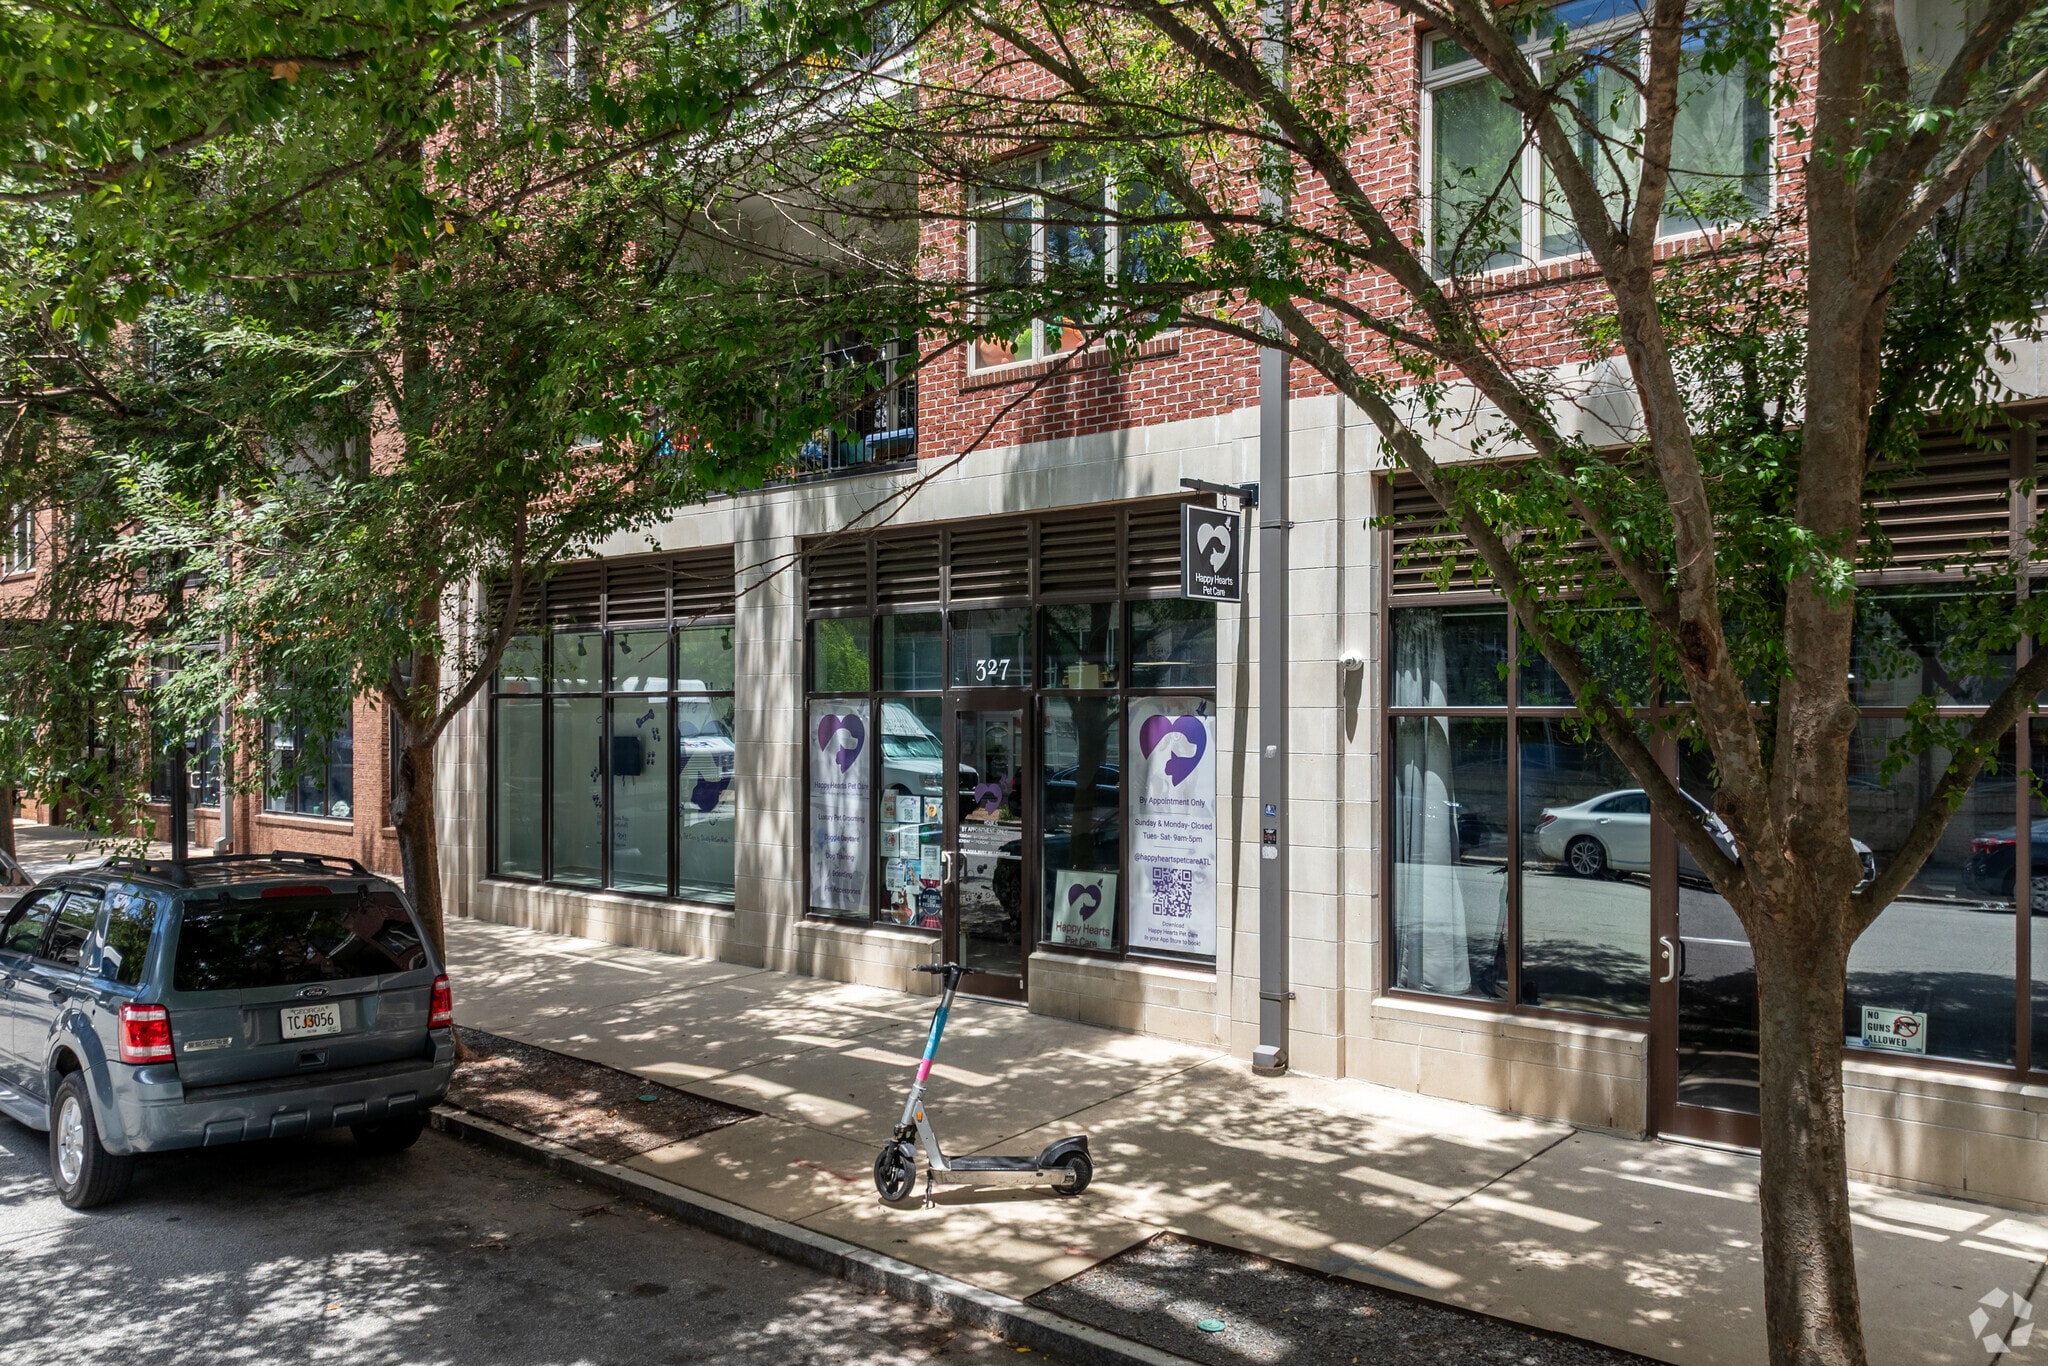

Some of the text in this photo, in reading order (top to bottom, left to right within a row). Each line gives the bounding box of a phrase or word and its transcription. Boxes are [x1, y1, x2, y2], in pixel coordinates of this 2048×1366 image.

[1195, 572, 1233, 586] Happy Hearts
[1203, 585, 1225, 596] Pet Care
[976, 659, 1010, 681] 327
[815, 781, 829, 790] Happy
[1139, 796, 1205, 808] By Appointment Only
[842, 815, 865, 824] Grooming
[1135, 819, 1156, 828] Sunday
[1191, 822, 1212, 830] Closed
[1173, 834, 1203, 843] 9am-5pm
[1134, 853, 1211, 866] @happyheartspetcareATL
[1056, 921, 1110, 937] Happy Hearts
[1162, 921, 1185, 929] Download
[1148, 927, 1162, 935] Happy
[1065, 935, 1097, 947] Pet Care
[1159, 935, 1169, 943] App
[293, 1007, 325, 1015] GEORGIA
[1868, 1011, 1879, 1019] NO
[1867, 1022, 1890, 1032] GUNS
[1868, 1035, 1907, 1046] ALLOWED
